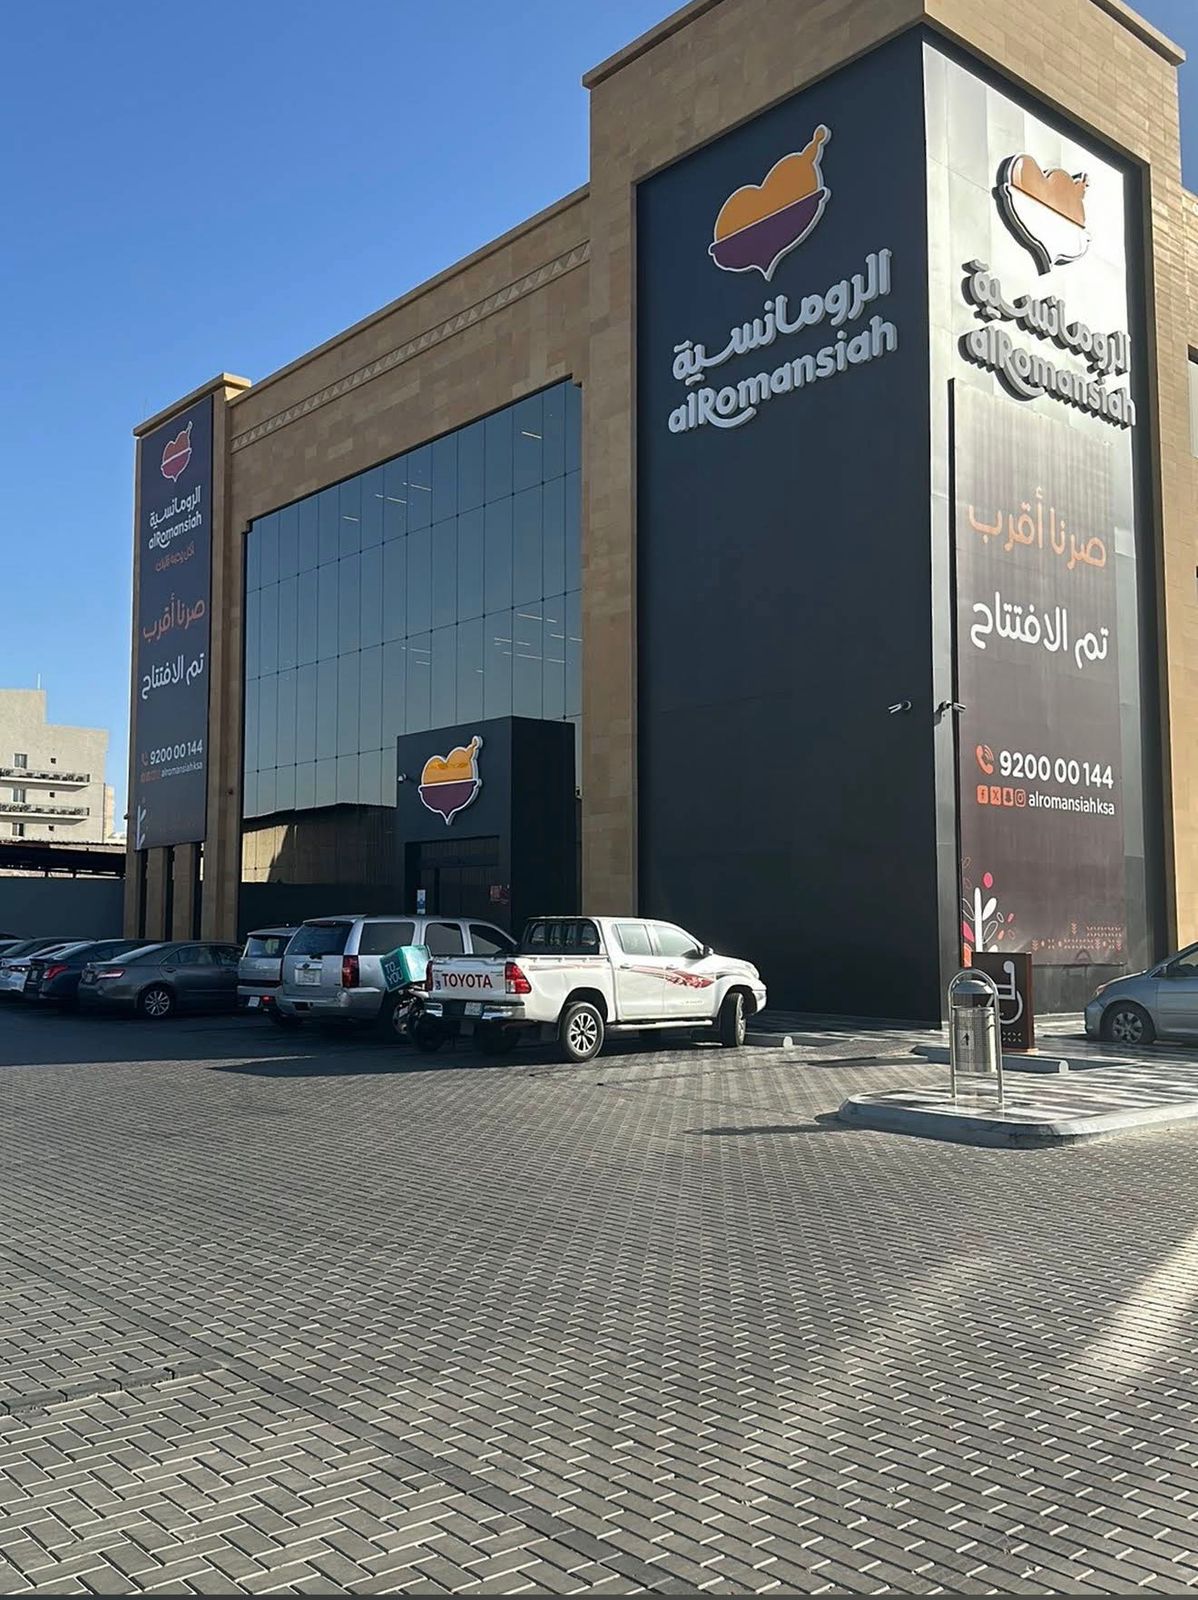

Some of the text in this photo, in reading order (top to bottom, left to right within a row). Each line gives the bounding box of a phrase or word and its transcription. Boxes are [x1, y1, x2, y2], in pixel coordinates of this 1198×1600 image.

[672, 249, 892, 386] الرومانسية
[963, 260, 1132, 376] الرومانسية
[668, 316, 898, 433] alRomansiah
[960, 328, 1137, 430] alRomansiah
[149, 511, 202, 550] alRomansiah
[150, 485, 201, 529] الرومانسية
[968, 486, 1106, 570] صرنا أقرب
[143, 592, 205, 643] صرنا أقرب
[970, 591, 1109, 670] تم الافتتاح
[142, 653, 204, 700] تم الافتتاح
[1028, 791, 1115, 815] alromansiahksa
[387, 970, 403, 985] YOU
[441, 973, 493, 988] TOYOTA
